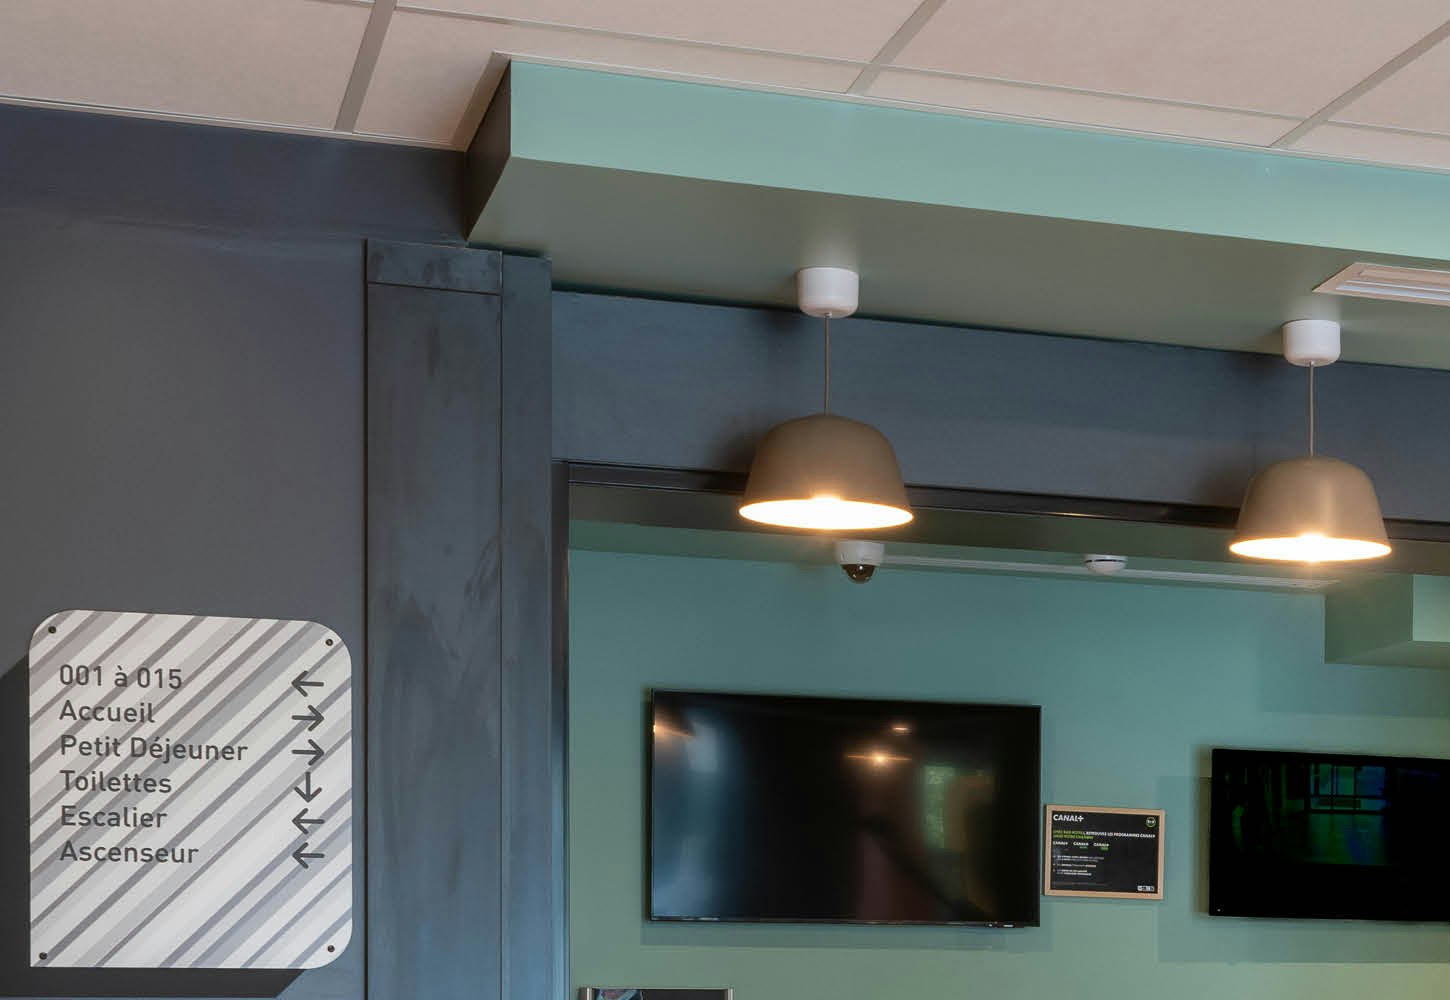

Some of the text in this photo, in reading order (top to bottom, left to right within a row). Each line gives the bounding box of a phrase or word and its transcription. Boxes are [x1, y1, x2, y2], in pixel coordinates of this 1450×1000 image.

[60, 664, 182, 689] 001 à 015
[59, 699, 155, 723] Accueil
[60, 734, 248, 764] Petit Déjeuner
[59, 769, 172, 793] Toilettes
[61, 805, 168, 828] Escalier
[1053, 814, 1084, 822] CANAL+
[59, 840, 199, 863] Ascenseur
